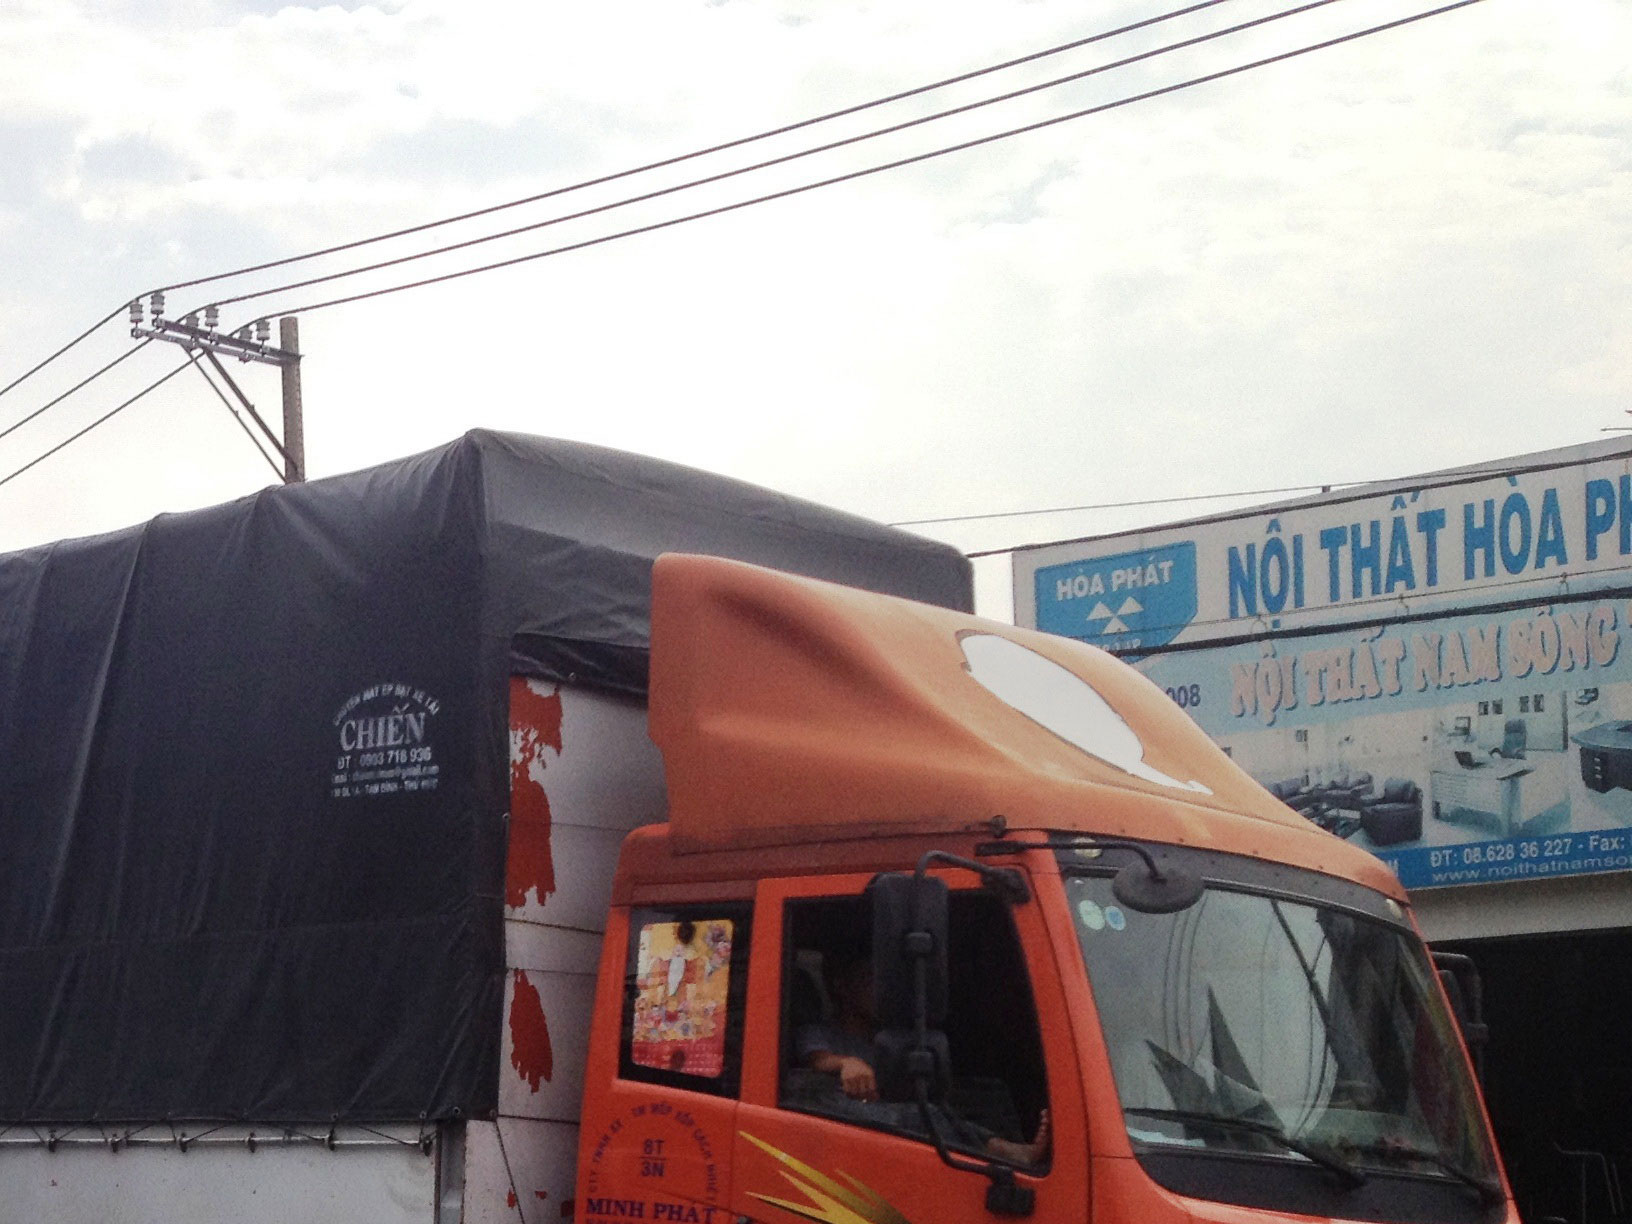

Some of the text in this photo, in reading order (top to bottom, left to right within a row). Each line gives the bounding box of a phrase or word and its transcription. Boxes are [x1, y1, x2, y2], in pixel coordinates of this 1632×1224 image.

[1227, 518, 1306, 630] NỘI
[1319, 490, 1447, 603] THẤT
[1463, 475, 1568, 581] HÒA
[1056, 555, 1174, 601] HÒA PHÁT
[1230, 642, 1298, 726] NỘI
[1411, 622, 1503, 693] NAM
[1463, 843, 1515, 865] 08.628
[1519, 840, 1540, 859] 36
[1543, 837, 1572, 857] 227
[1588, 834, 1625, 852] Fax:
[1432, 854, 1632, 883] www.noithatnamso
[641, 1160, 665, 1178] 3N
[585, 1197, 645, 1219] MINH
